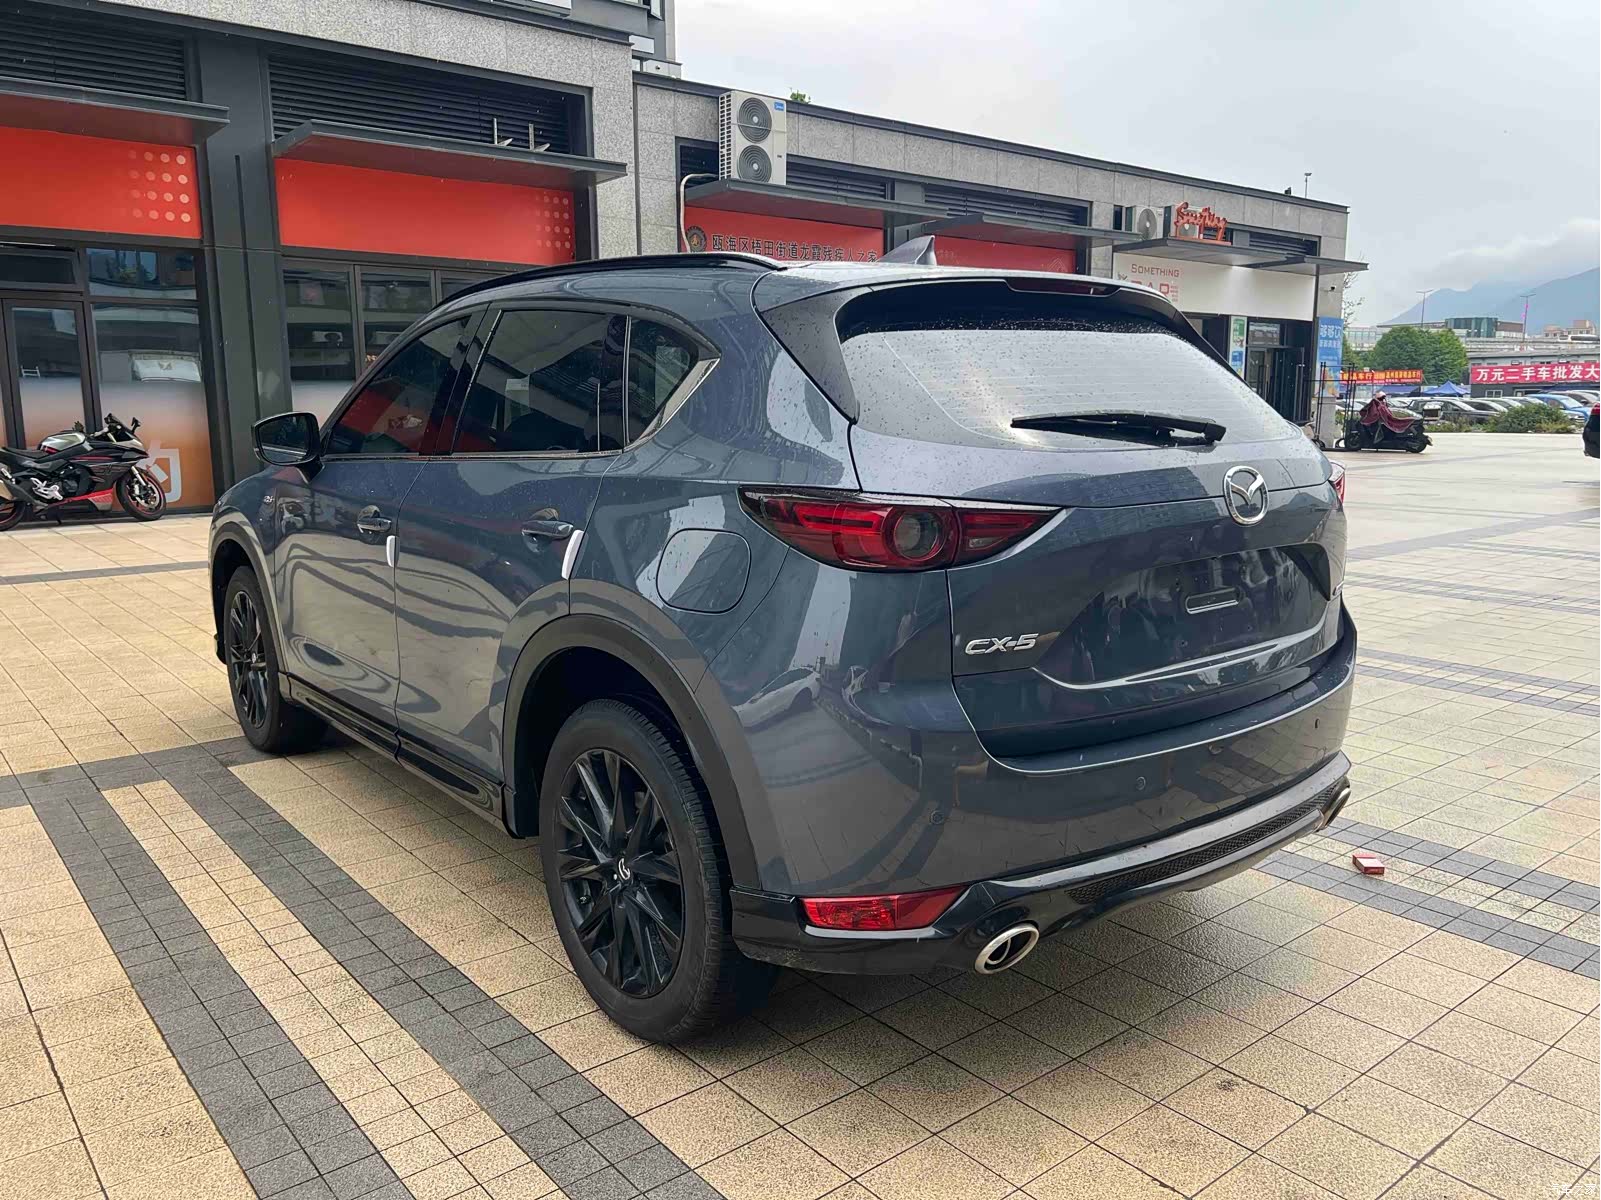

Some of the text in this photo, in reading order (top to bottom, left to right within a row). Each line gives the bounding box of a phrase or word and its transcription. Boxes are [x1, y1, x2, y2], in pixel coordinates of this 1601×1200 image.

[1476, 365, 1600, 380] 万元二手车批发大
[965, 633, 1039, 655] CX-5
